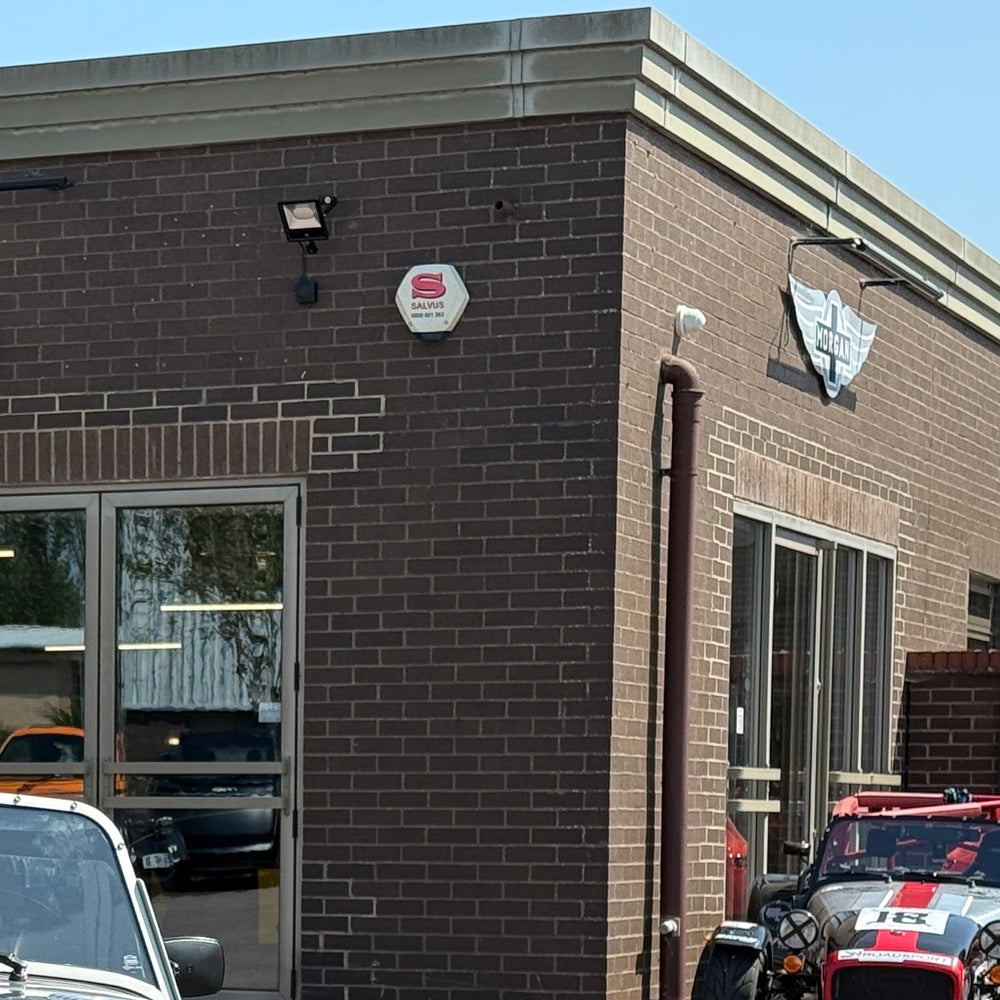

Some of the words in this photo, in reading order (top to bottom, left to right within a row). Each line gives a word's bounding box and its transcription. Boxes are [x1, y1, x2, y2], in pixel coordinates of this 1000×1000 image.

[411, 301, 444, 310] SALVUS
[816, 325, 850, 362] MORGAN
[872, 910, 931, 927] 18
